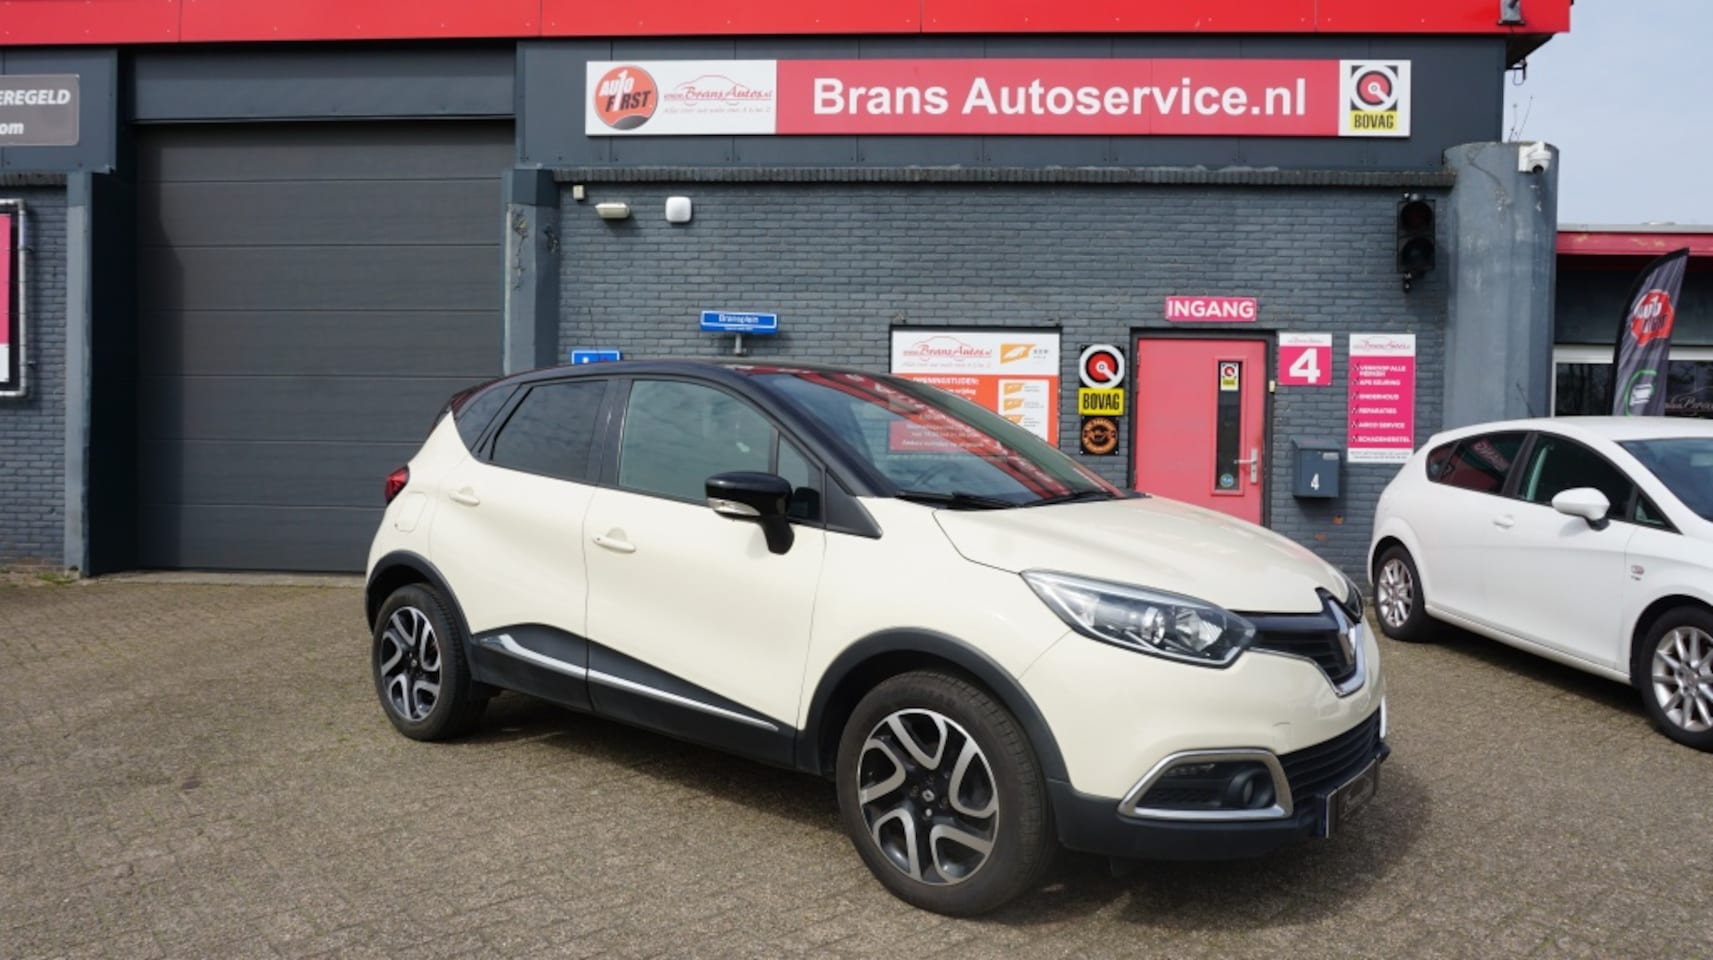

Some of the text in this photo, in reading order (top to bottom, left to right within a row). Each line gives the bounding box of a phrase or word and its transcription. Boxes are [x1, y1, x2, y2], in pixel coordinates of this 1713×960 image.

[605, 90, 652, 113] FIRST
[813, 76, 1306, 116] Brans Autoservice.nl
[1354, 114, 1394, 129] BOVAG
[1167, 300, 1255, 318] INGANG
[1289, 347, 1321, 384] 4
[1083, 392, 1120, 410] BOVAG
[1310, 473, 1320, 491] 4
